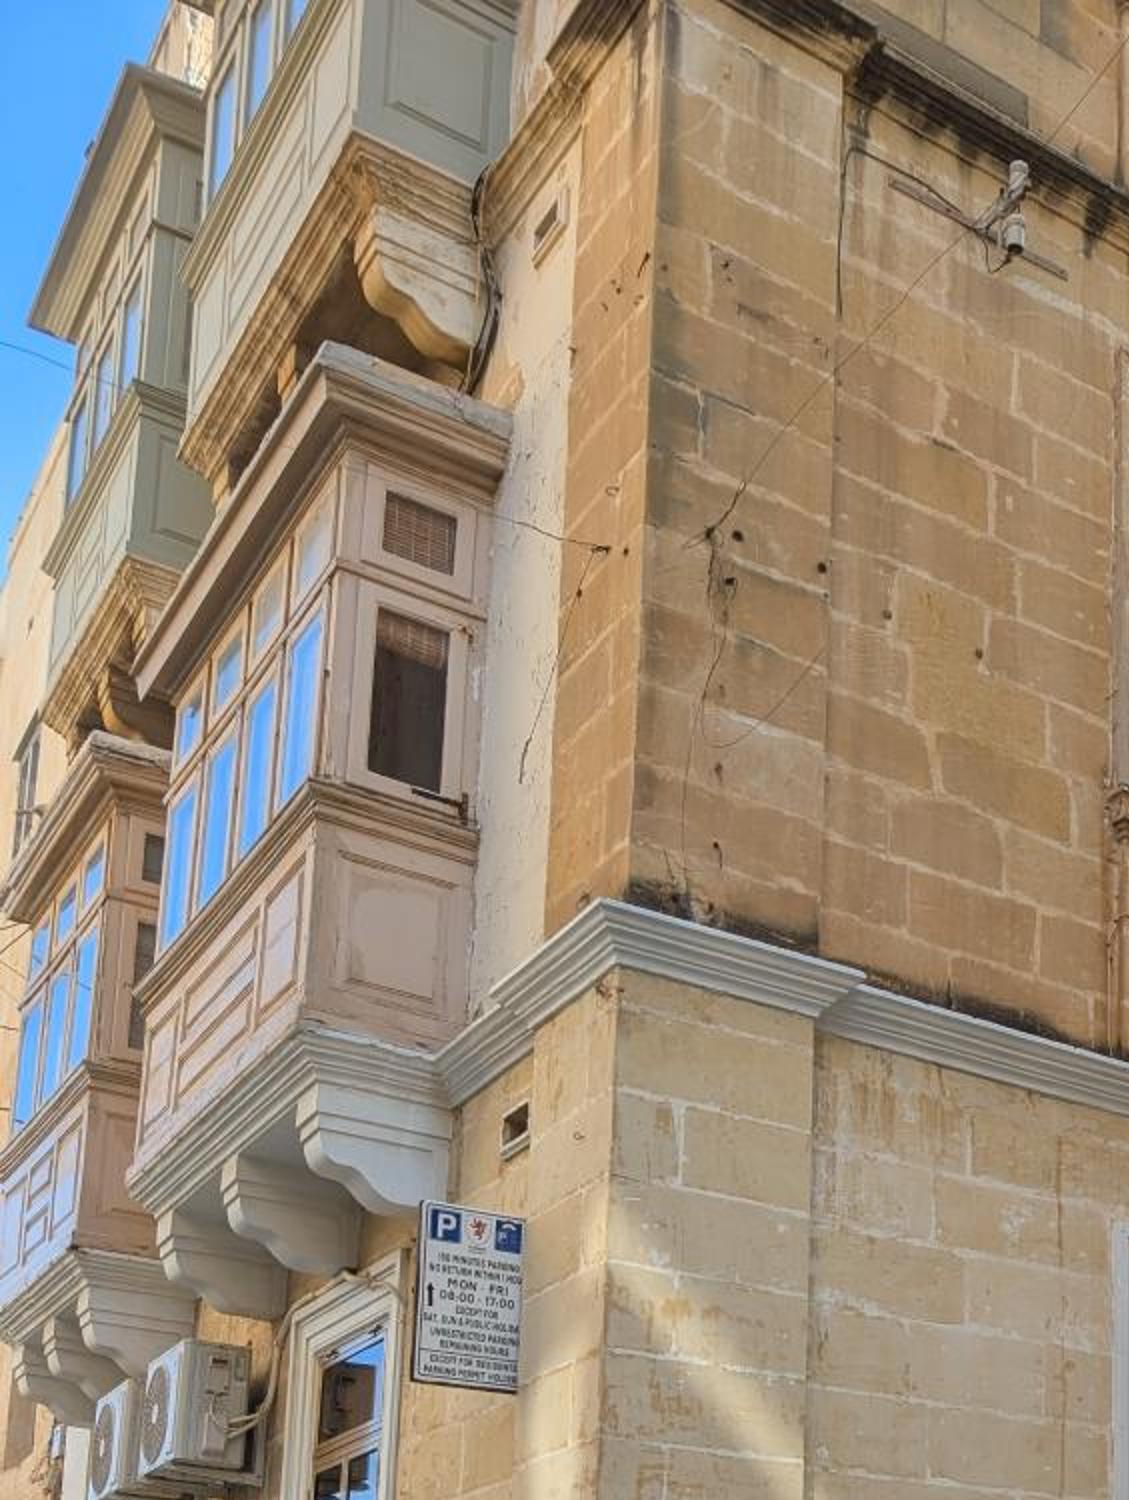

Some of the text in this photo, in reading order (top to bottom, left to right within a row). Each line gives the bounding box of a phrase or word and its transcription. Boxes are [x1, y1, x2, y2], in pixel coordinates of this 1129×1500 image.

[437, 1213, 457, 1240] P
[447, 1277, 477, 1291] MON
[489, 1284, 508, 1296] FRI
[439, 1289, 474, 1303] 08:00
[485, 1295, 514, 1309] 17:00
